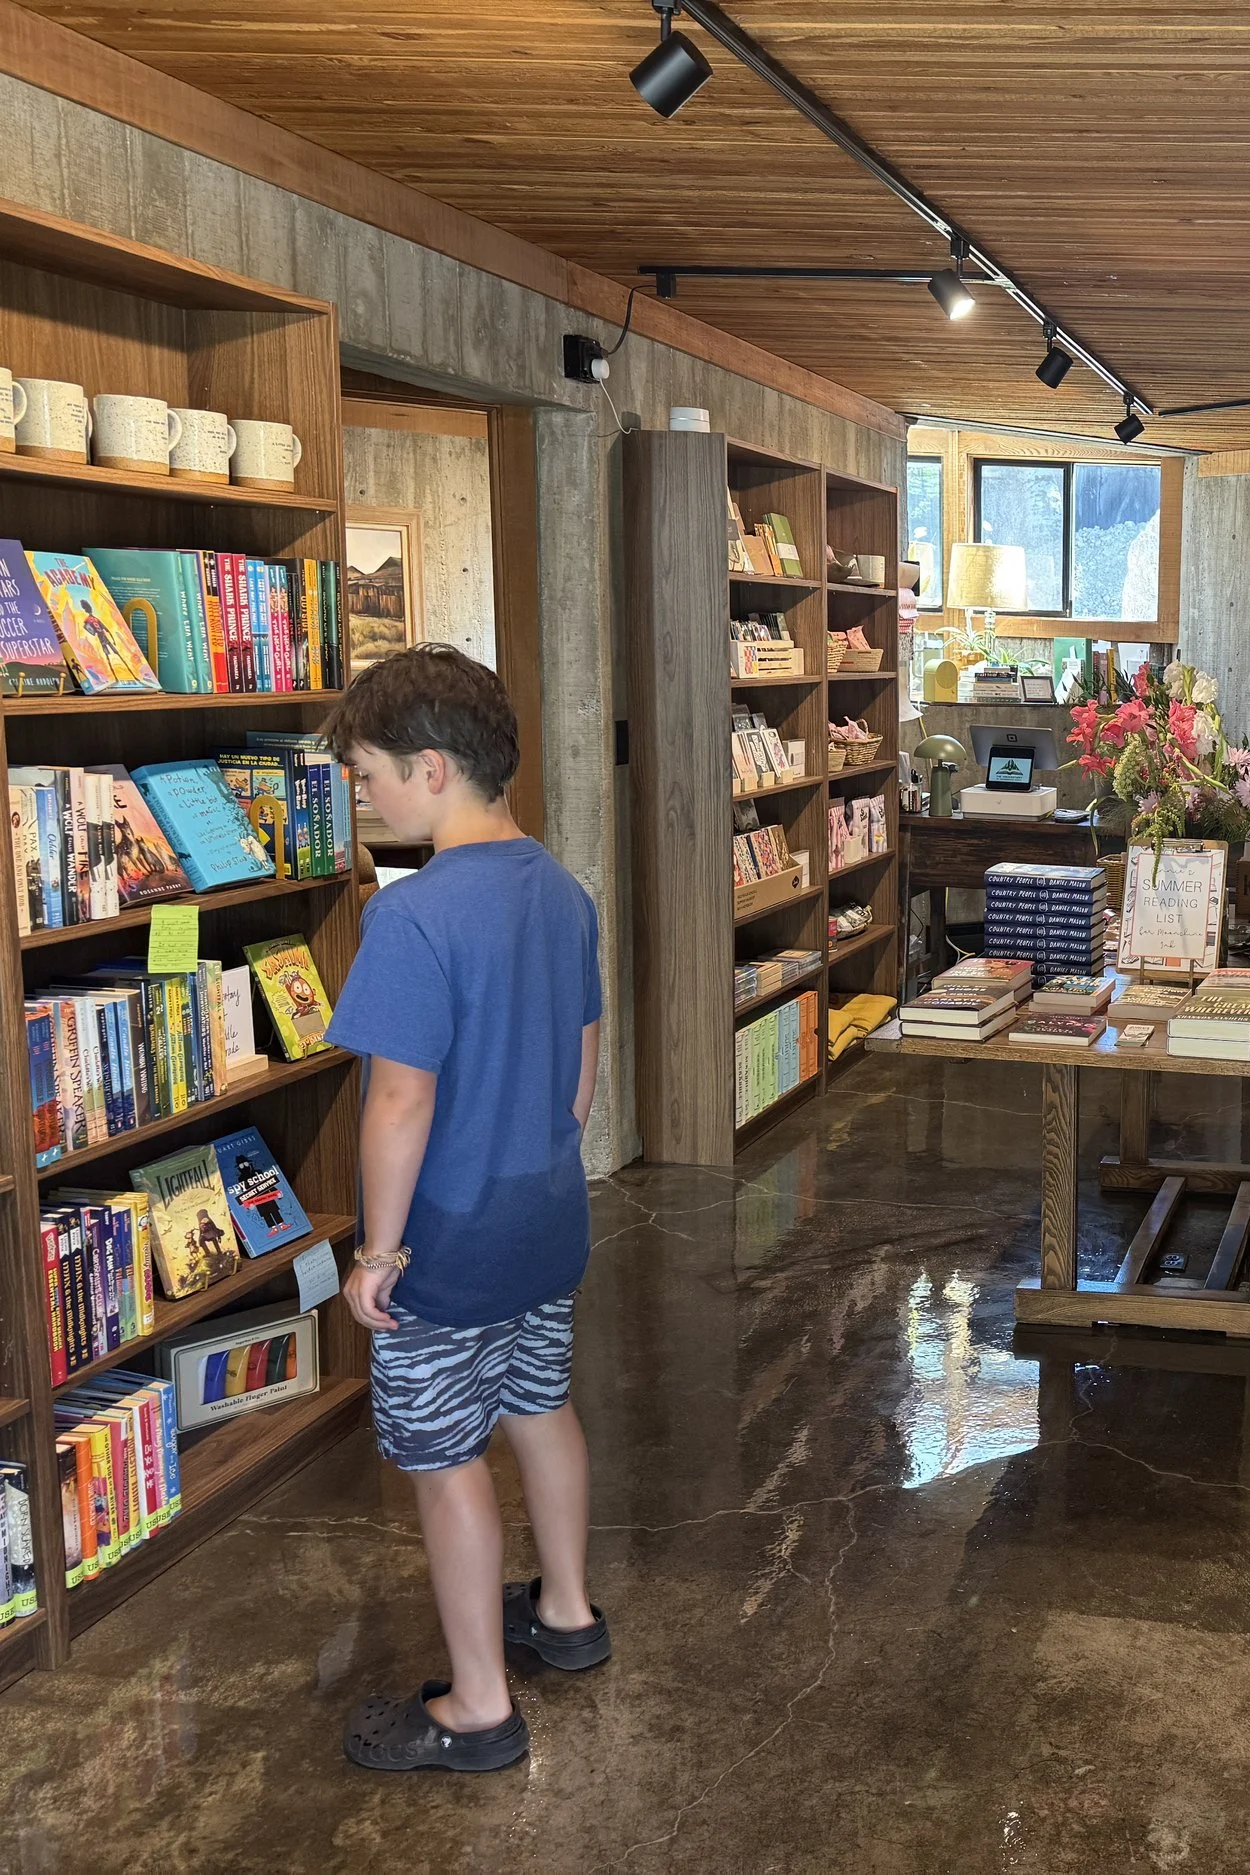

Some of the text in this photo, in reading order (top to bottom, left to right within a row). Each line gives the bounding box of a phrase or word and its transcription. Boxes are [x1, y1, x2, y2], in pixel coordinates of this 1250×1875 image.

[44, 569, 96, 590] ACADEMY
[224, 574, 238, 641] SHARK PRINCE
[238, 575, 251, 641] SHARK PRINCE
[2, 638, 54, 660] SUPERSTAR
[76, 808, 86, 832] WOLF
[29, 832, 37, 852] PAX
[47, 833, 56, 859] Odder
[63, 810, 77, 892] WOLF WANDER
[988, 876, 1086, 888] COUNTRY PEOPLE DANIEL MASON
[1142, 879, 1203, 893] SUMMER
[992, 889, 1089, 901] COUNTRY PEOPLE DANIEL MASON
[1144, 897, 1198, 909] READING
[991, 901, 1089, 913] COUNTRY PEOPLE DANIEL MASON
[1016, 915, 1033, 923] PEOPLE
[1049, 916, 1067, 924] DANIEL
[1069, 917, 1086, 925] MASON
[1156, 914, 1183, 924] LIST
[989, 926, 1014, 934] COUNTRY
[1016, 927, 1034, 935] PEOPLE
[1070, 930, 1087, 938] MASON
[988, 938, 1086, 950] COUNTRY PEOPLE DANIEL MASON
[988, 949, 1086, 962] COUNTRY PEOPLE DANIEL MASON
[66, 1017, 87, 1133] GRIFFIN SPEAKER
[156, 1160, 215, 1211] LIGHTFALL
[227, 1165, 280, 1195] spy school
[66, 1310, 76, 1353] Midknights
[77, 1303, 86, 1346] Midknights
